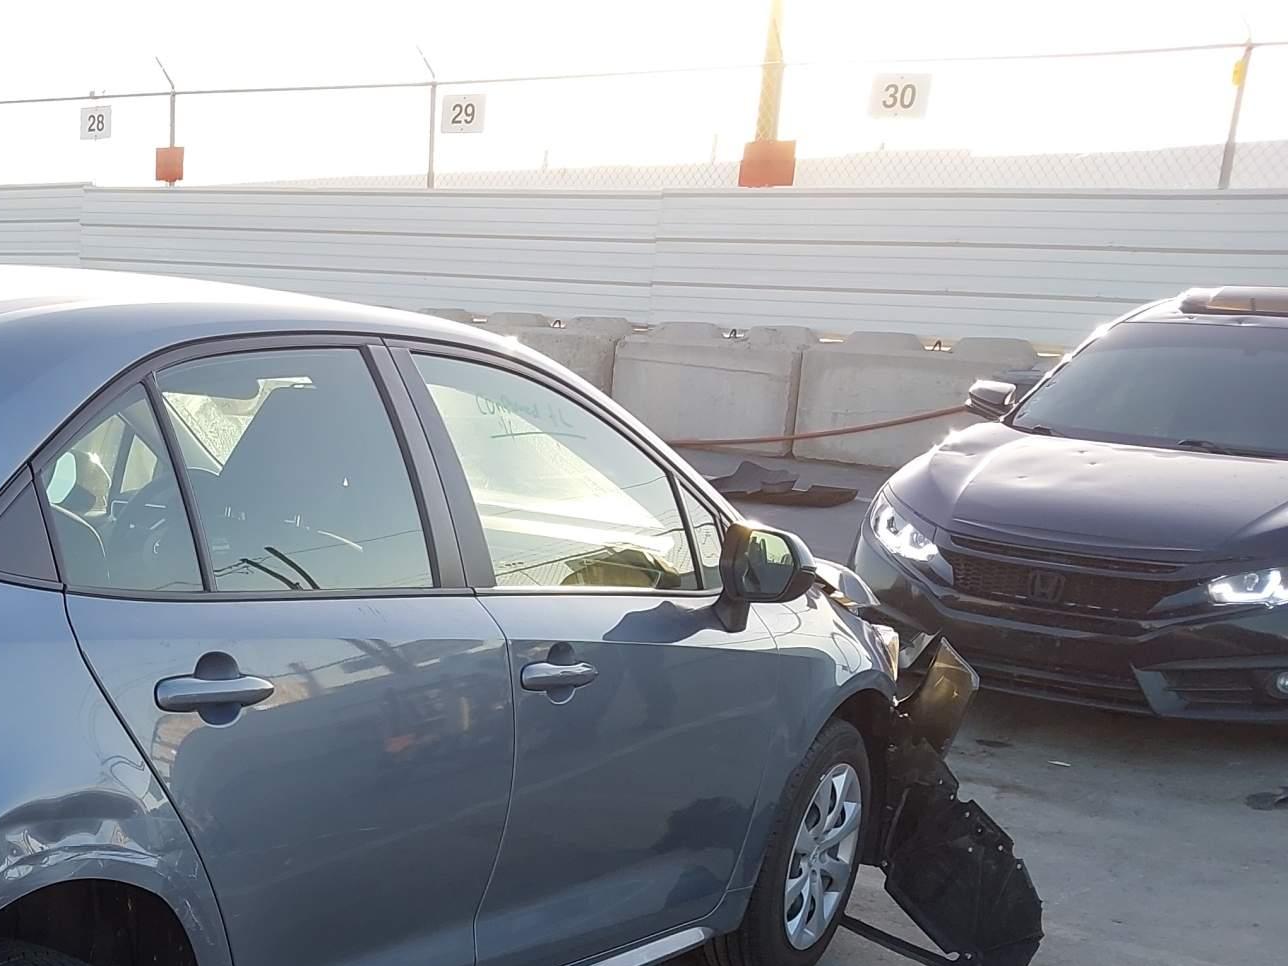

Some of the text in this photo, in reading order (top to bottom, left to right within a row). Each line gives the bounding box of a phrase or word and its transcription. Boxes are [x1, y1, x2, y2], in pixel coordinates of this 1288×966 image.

[882, 83, 917, 109] 30
[87, 114, 105, 132] 28
[451, 102, 476, 124] 29
